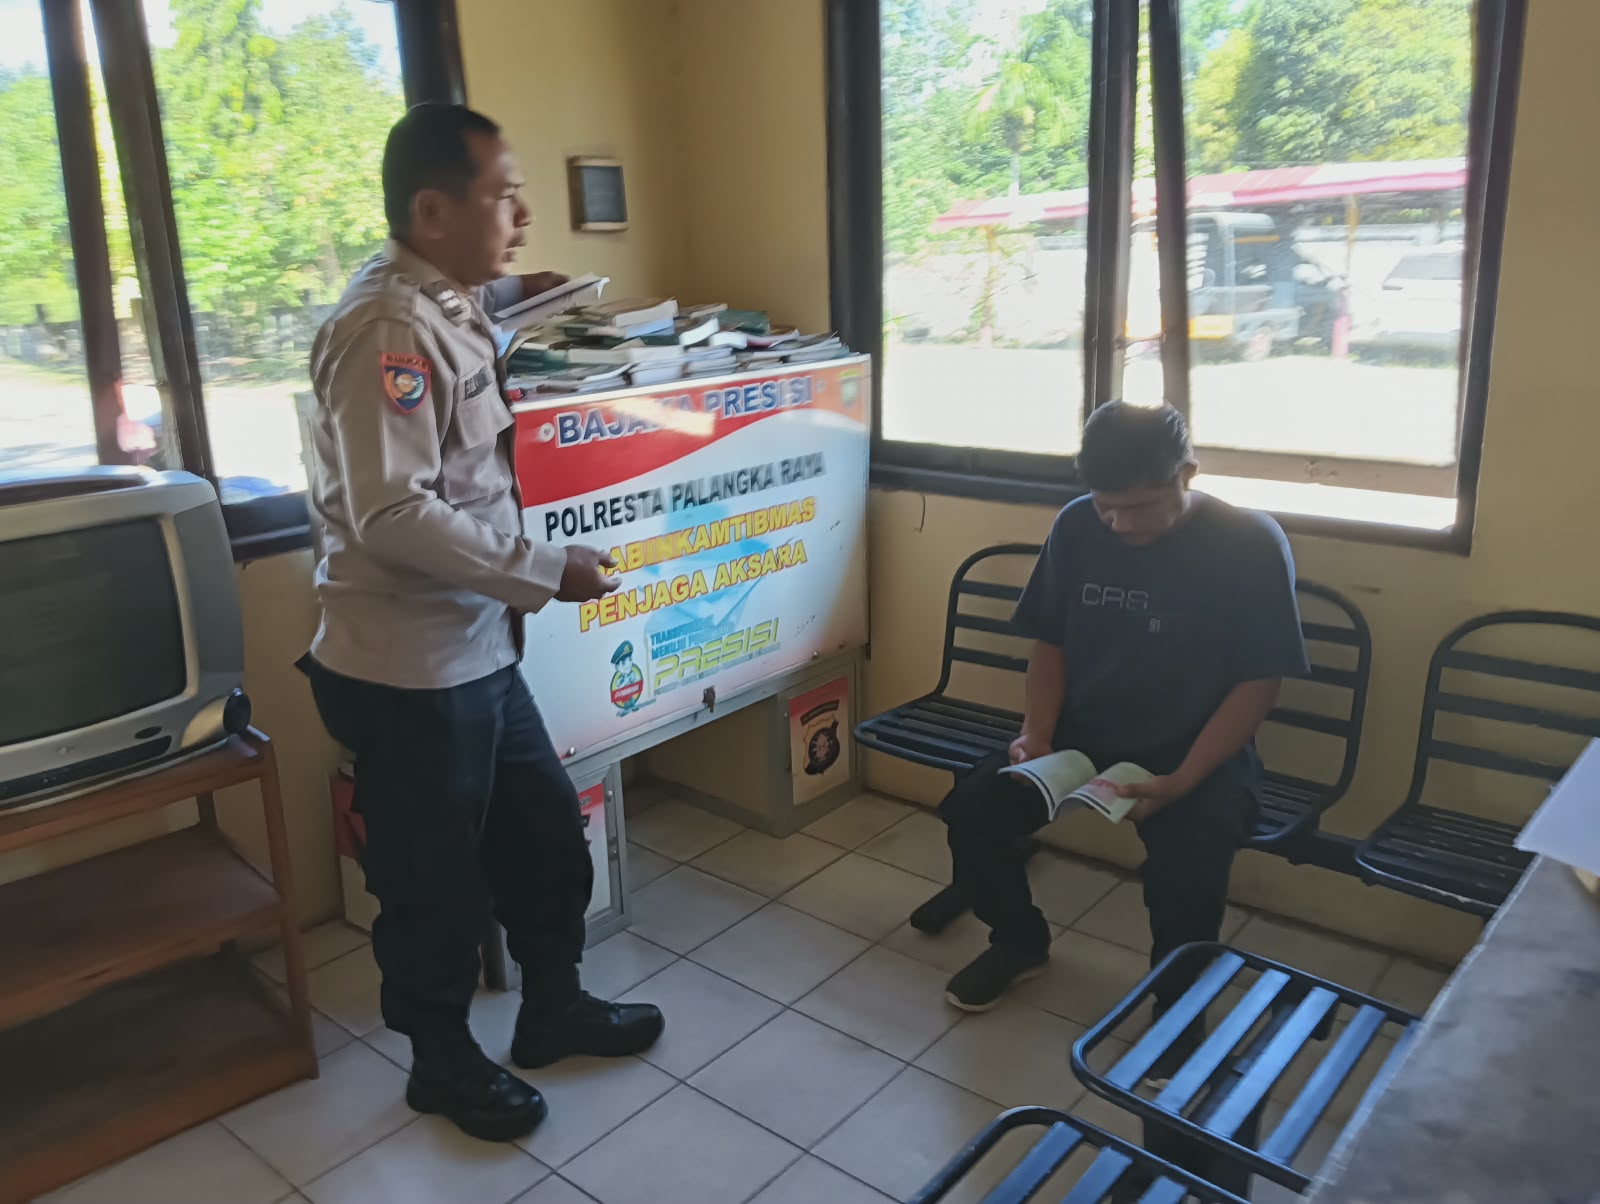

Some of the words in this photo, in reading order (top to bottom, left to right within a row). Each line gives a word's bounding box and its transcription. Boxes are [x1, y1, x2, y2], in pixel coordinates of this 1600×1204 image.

[556, 394, 697, 448] BAJAA
[704, 375, 813, 419] PRESISI
[545, 486, 667, 541] POLRESTA
[671, 462, 778, 512] PALANGKA
[780, 452, 826, 484] RAYA
[599, 496, 816, 576] ABINKAMTIBMAS
[579, 569, 708, 633] PENJAGA
[713, 540, 808, 591] AKSARA
[655, 618, 779, 688] PRESISI
